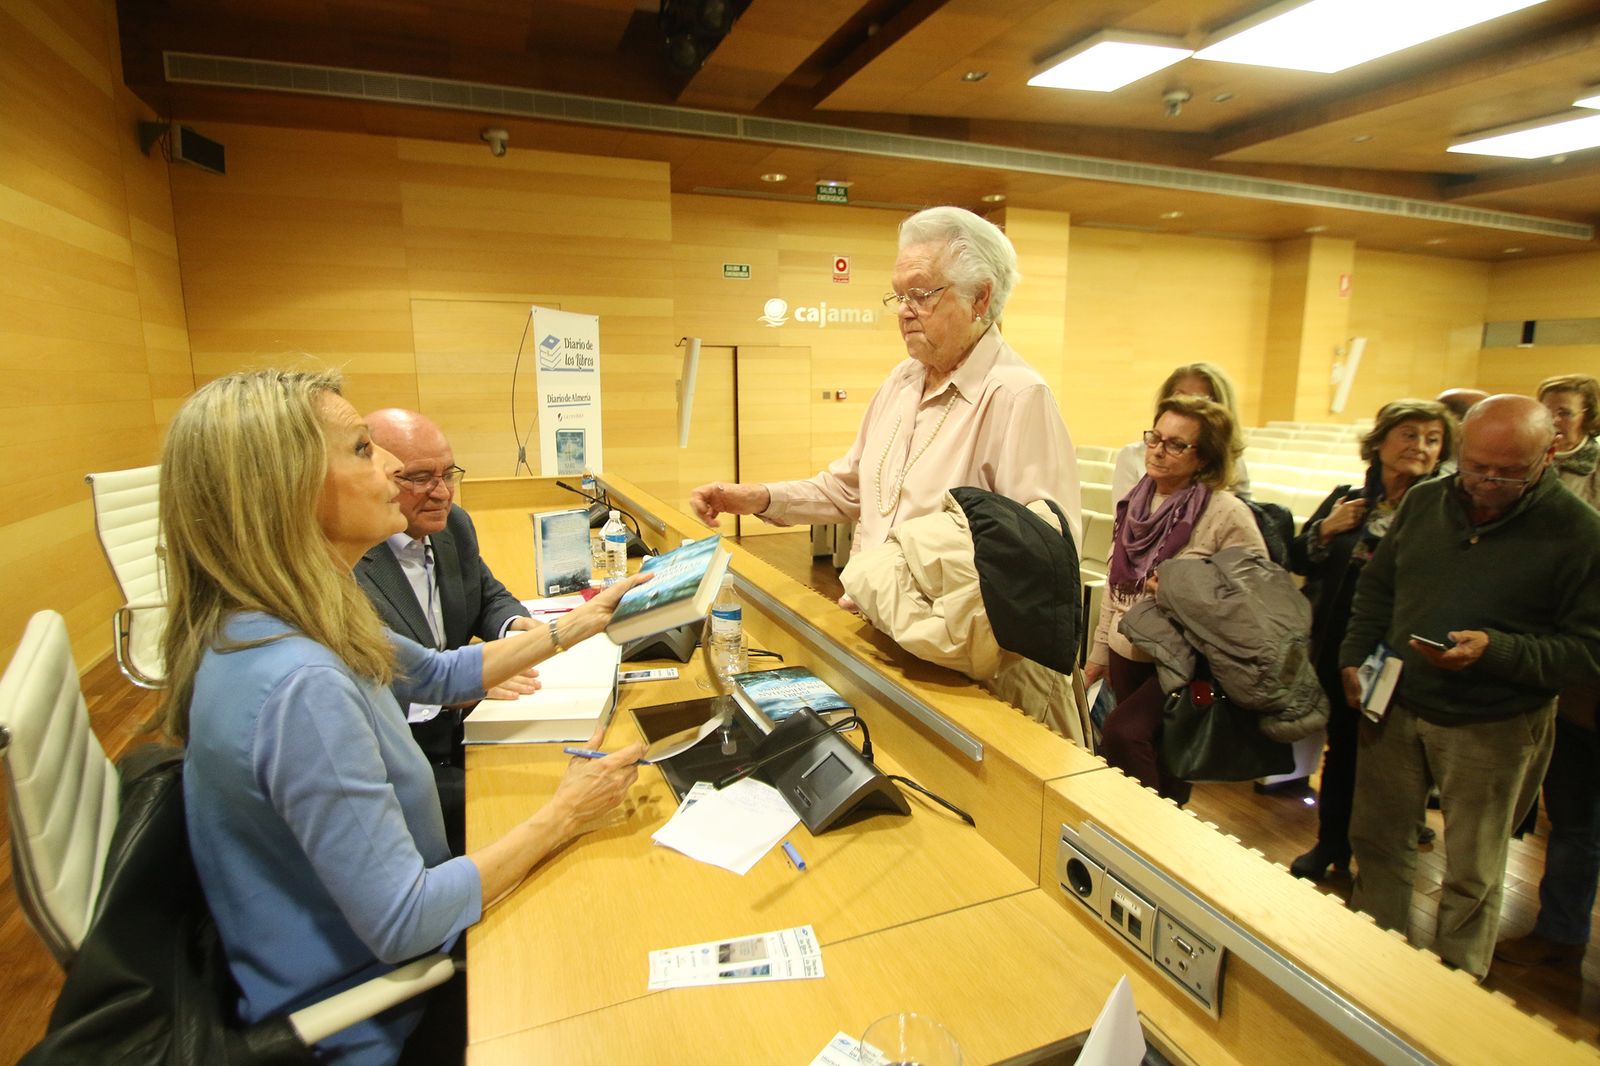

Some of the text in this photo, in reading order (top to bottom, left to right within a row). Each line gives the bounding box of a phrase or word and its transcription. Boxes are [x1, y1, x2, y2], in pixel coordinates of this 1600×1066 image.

[564, 337, 594, 351] Diario de
[546, 393, 565, 404] Diario
[564, 393, 572, 403] de
